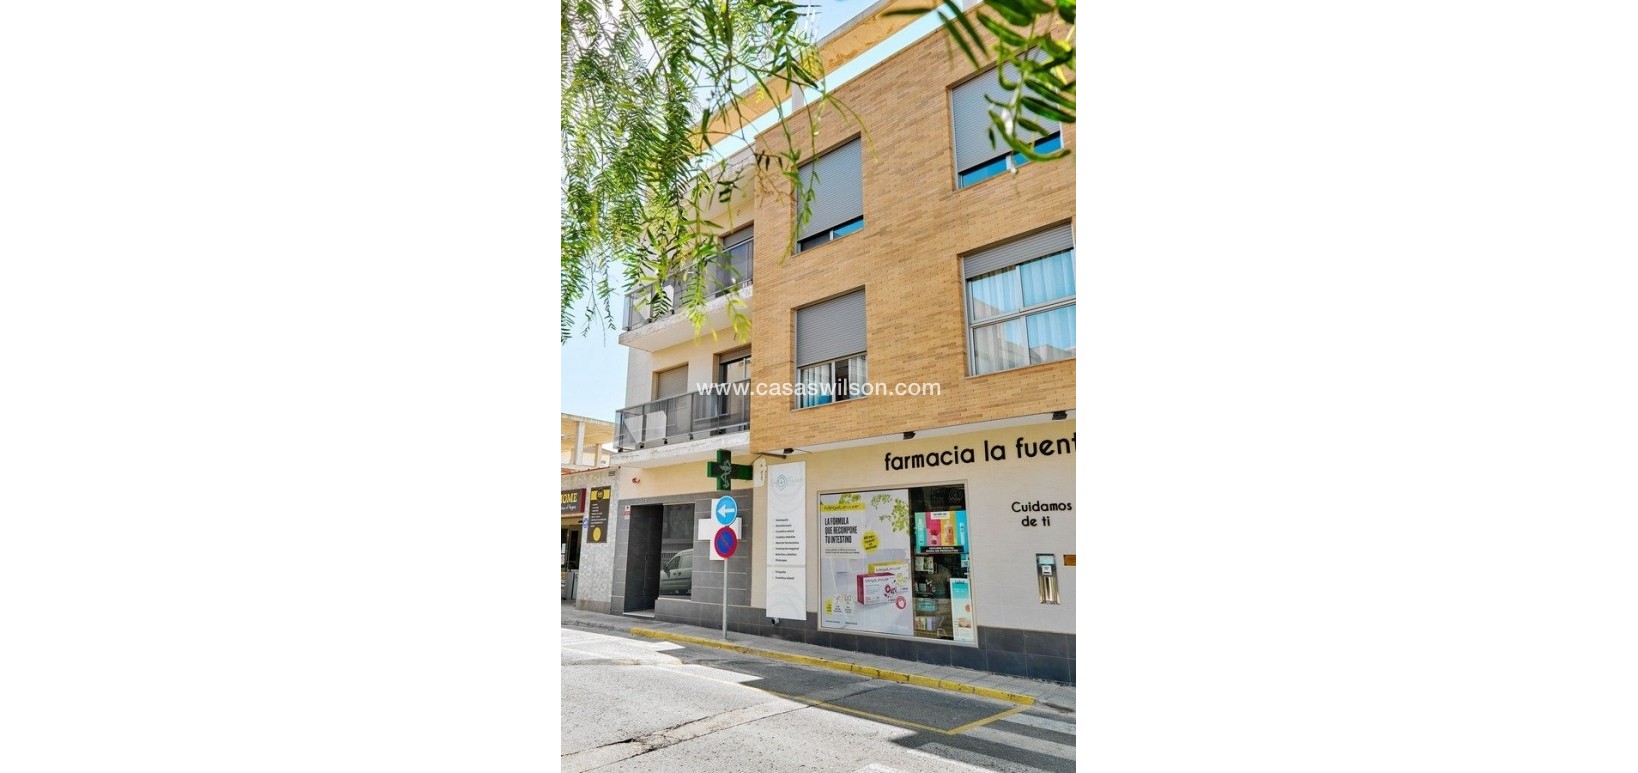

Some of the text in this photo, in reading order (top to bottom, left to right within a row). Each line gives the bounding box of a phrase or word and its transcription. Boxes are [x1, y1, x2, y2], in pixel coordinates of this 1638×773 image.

[885, 445, 975, 471] farmacia
[984, 440, 1006, 462] la
[1011, 501, 1072, 513] Cuidamos
[825, 517, 830, 525] LA
[1021, 515, 1051, 527] de ti
[833, 526, 858, 534] RECOMPONE
[825, 535, 852, 544] TU INTESTINO
